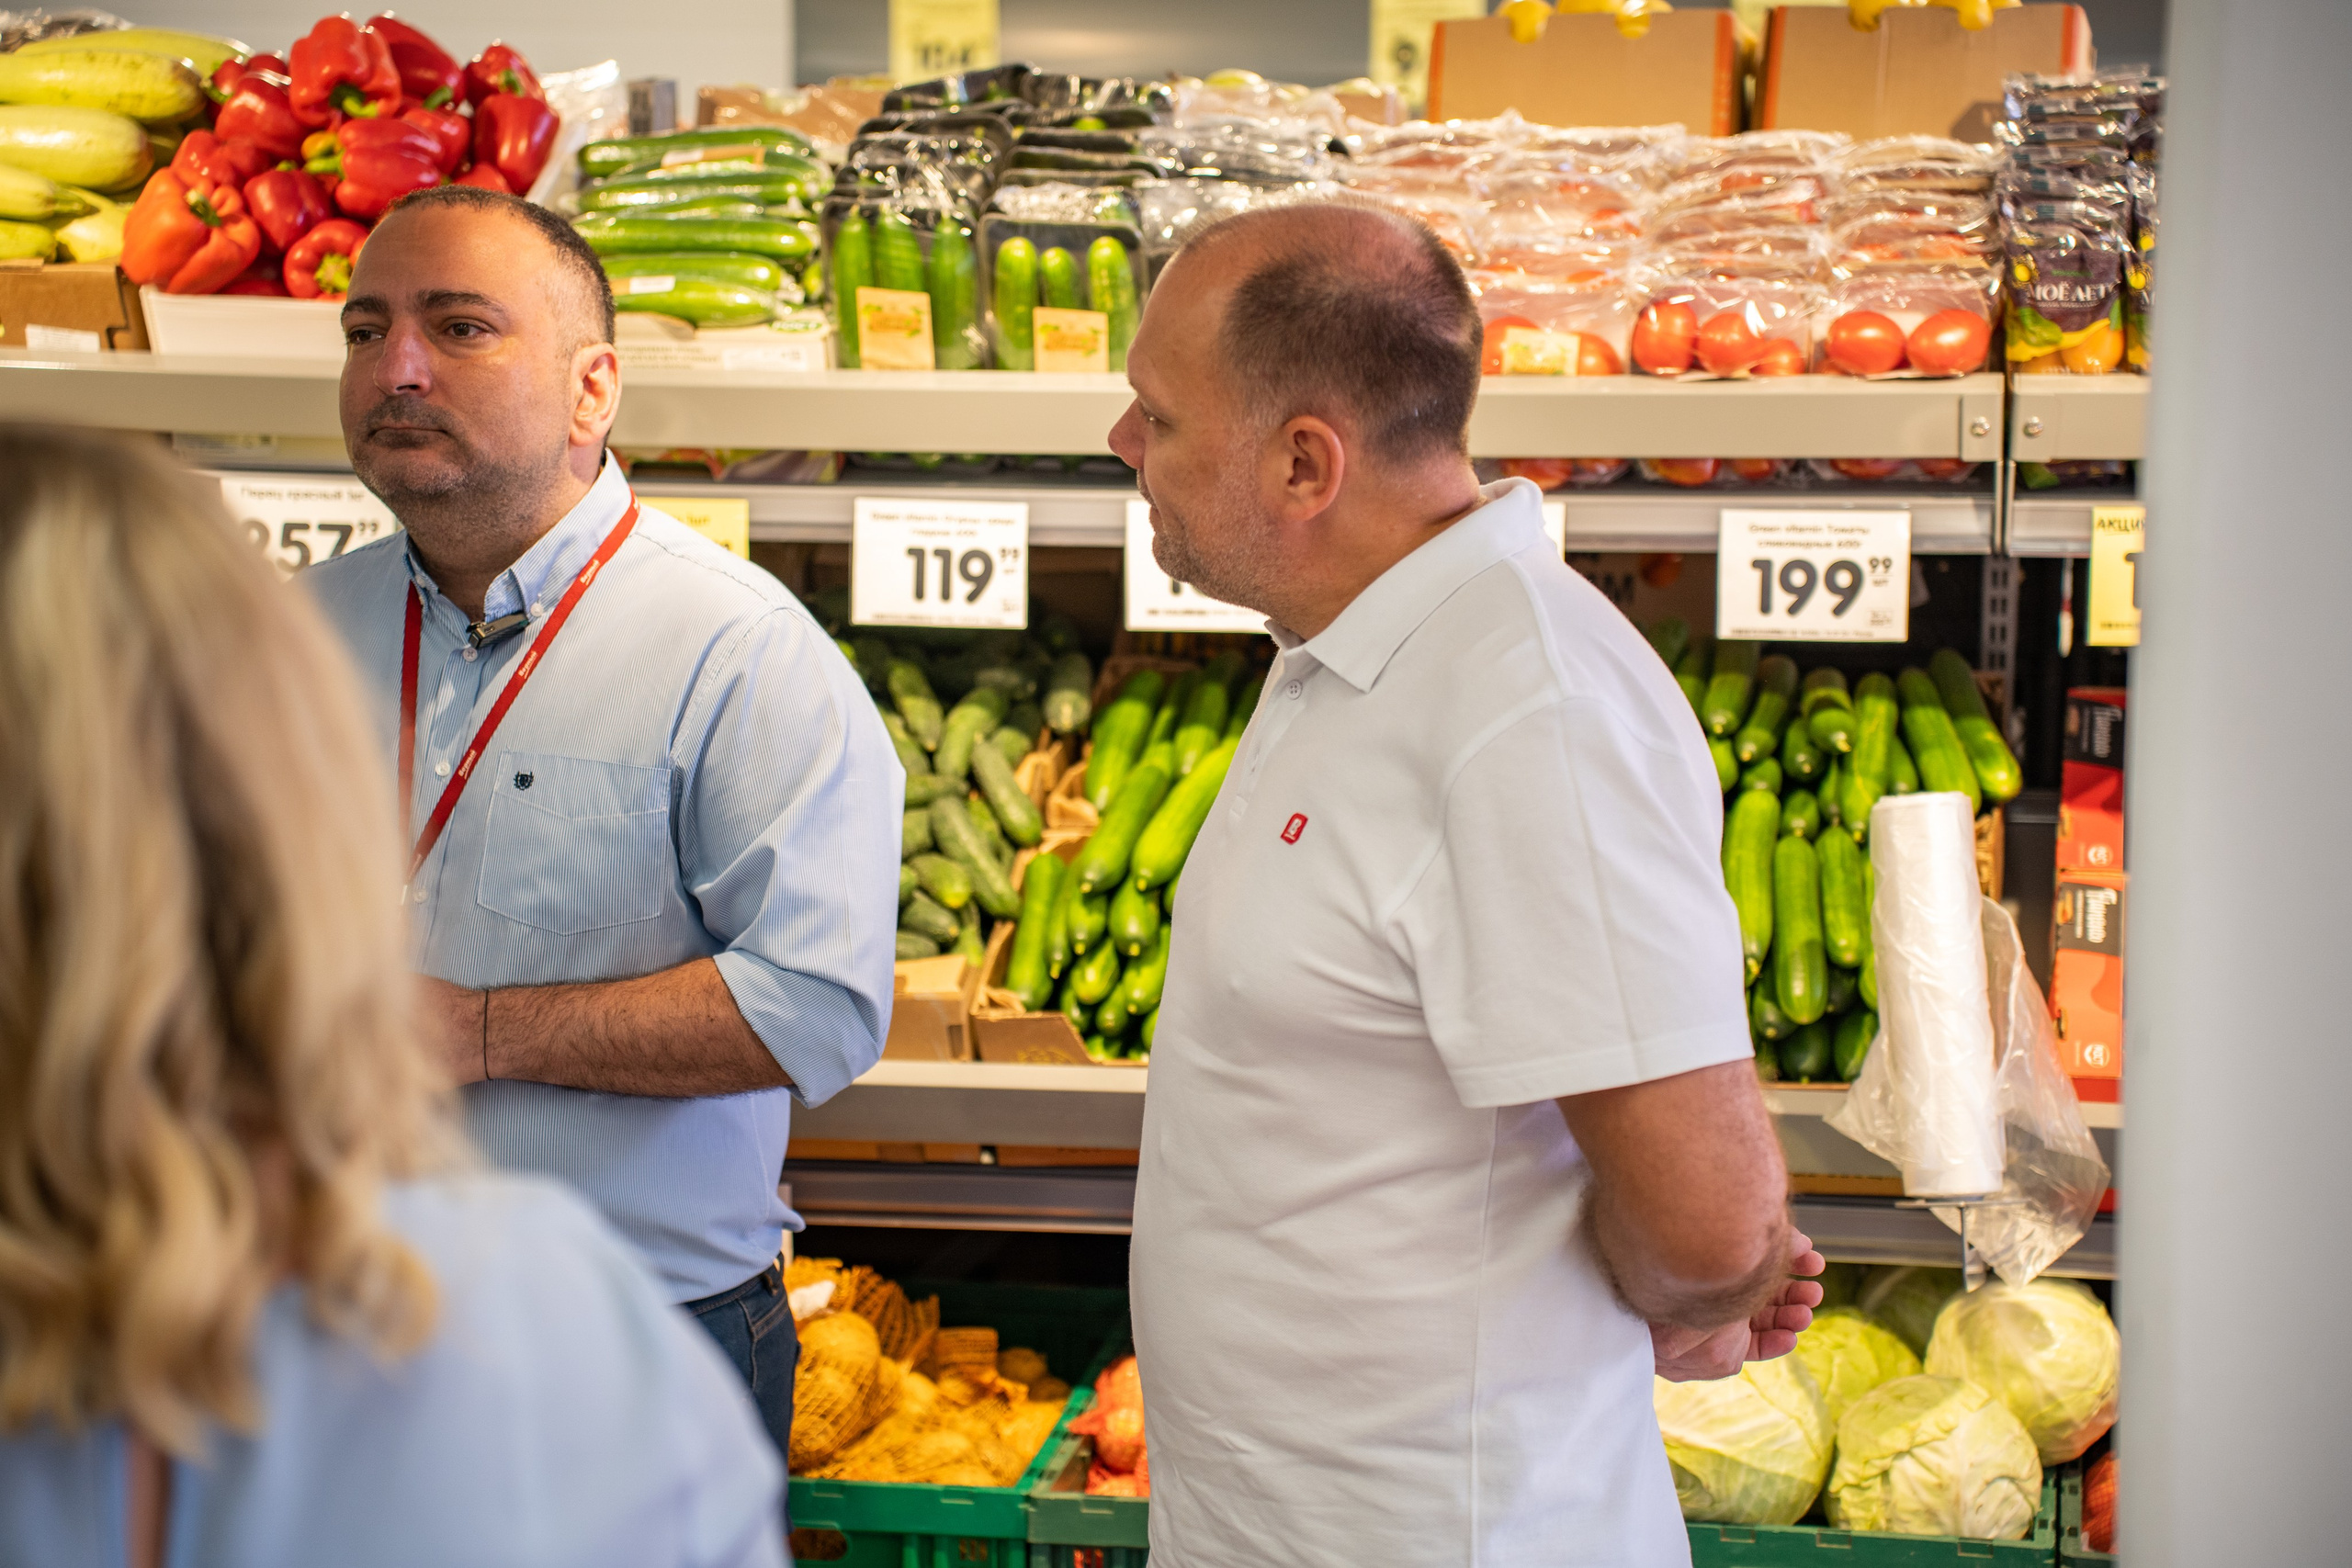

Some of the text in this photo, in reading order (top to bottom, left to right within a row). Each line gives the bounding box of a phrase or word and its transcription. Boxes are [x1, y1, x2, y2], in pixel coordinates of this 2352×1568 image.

[908, 548, 993, 603] 119
[1752, 559, 1863, 618] 199
[1870, 558, 1893, 573] 99
[518, 650, 537, 677] Верный
[458, 749, 477, 777] Верный
